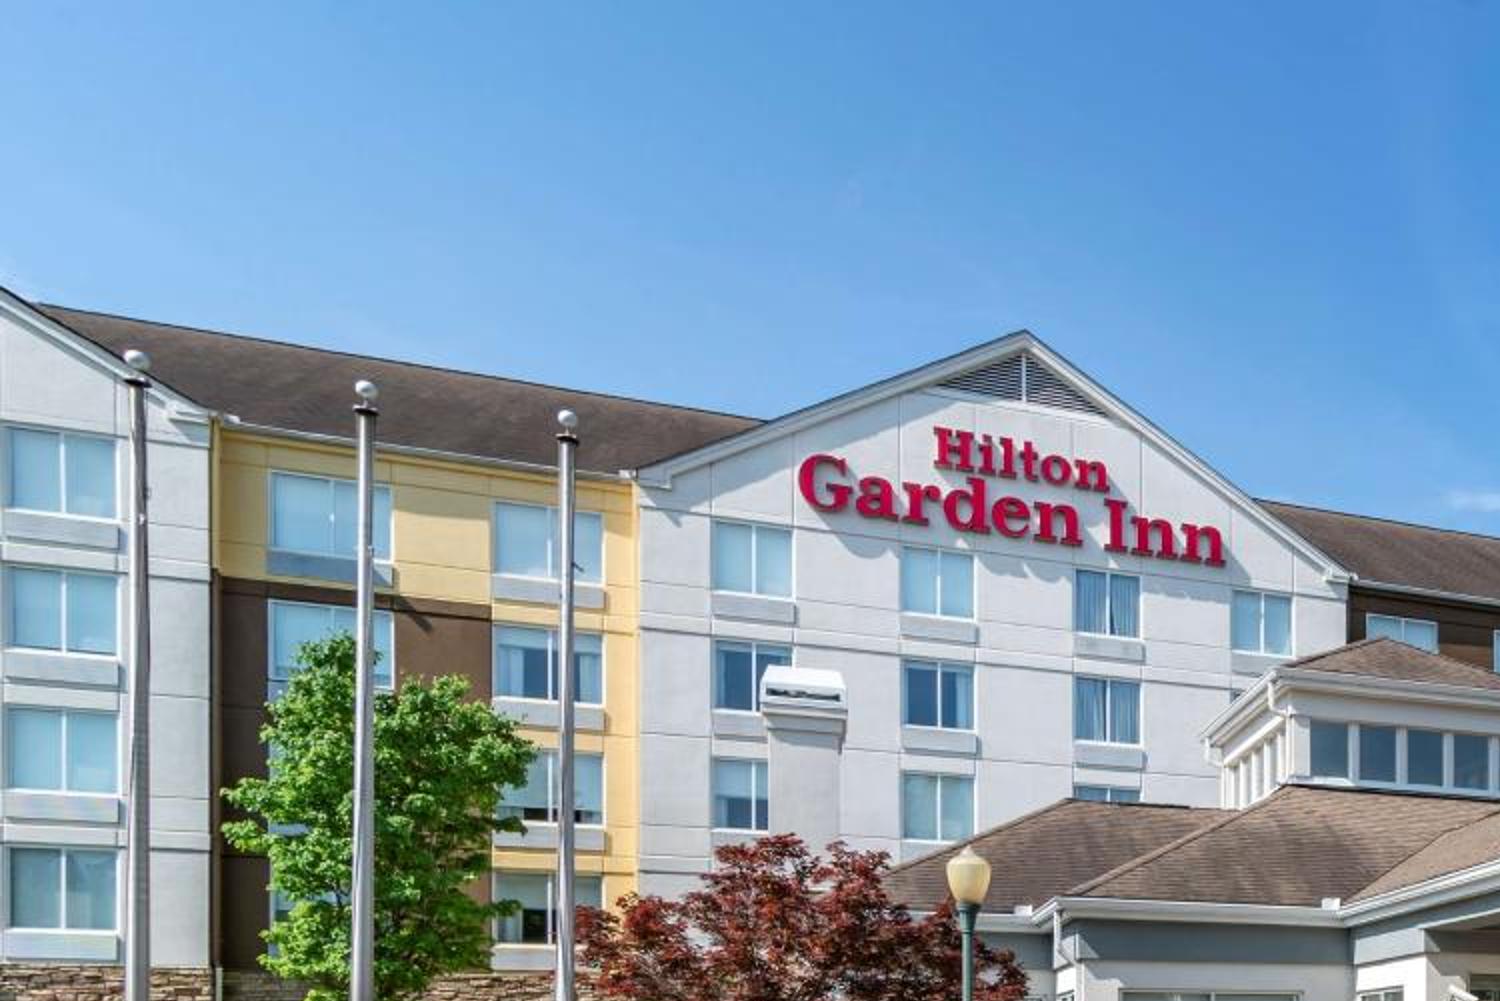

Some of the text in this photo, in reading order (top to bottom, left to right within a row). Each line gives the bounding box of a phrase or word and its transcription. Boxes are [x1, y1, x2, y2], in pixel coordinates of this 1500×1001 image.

[933, 426, 1110, 493] Hilton
[798, 454, 1226, 567] Garden Inn
